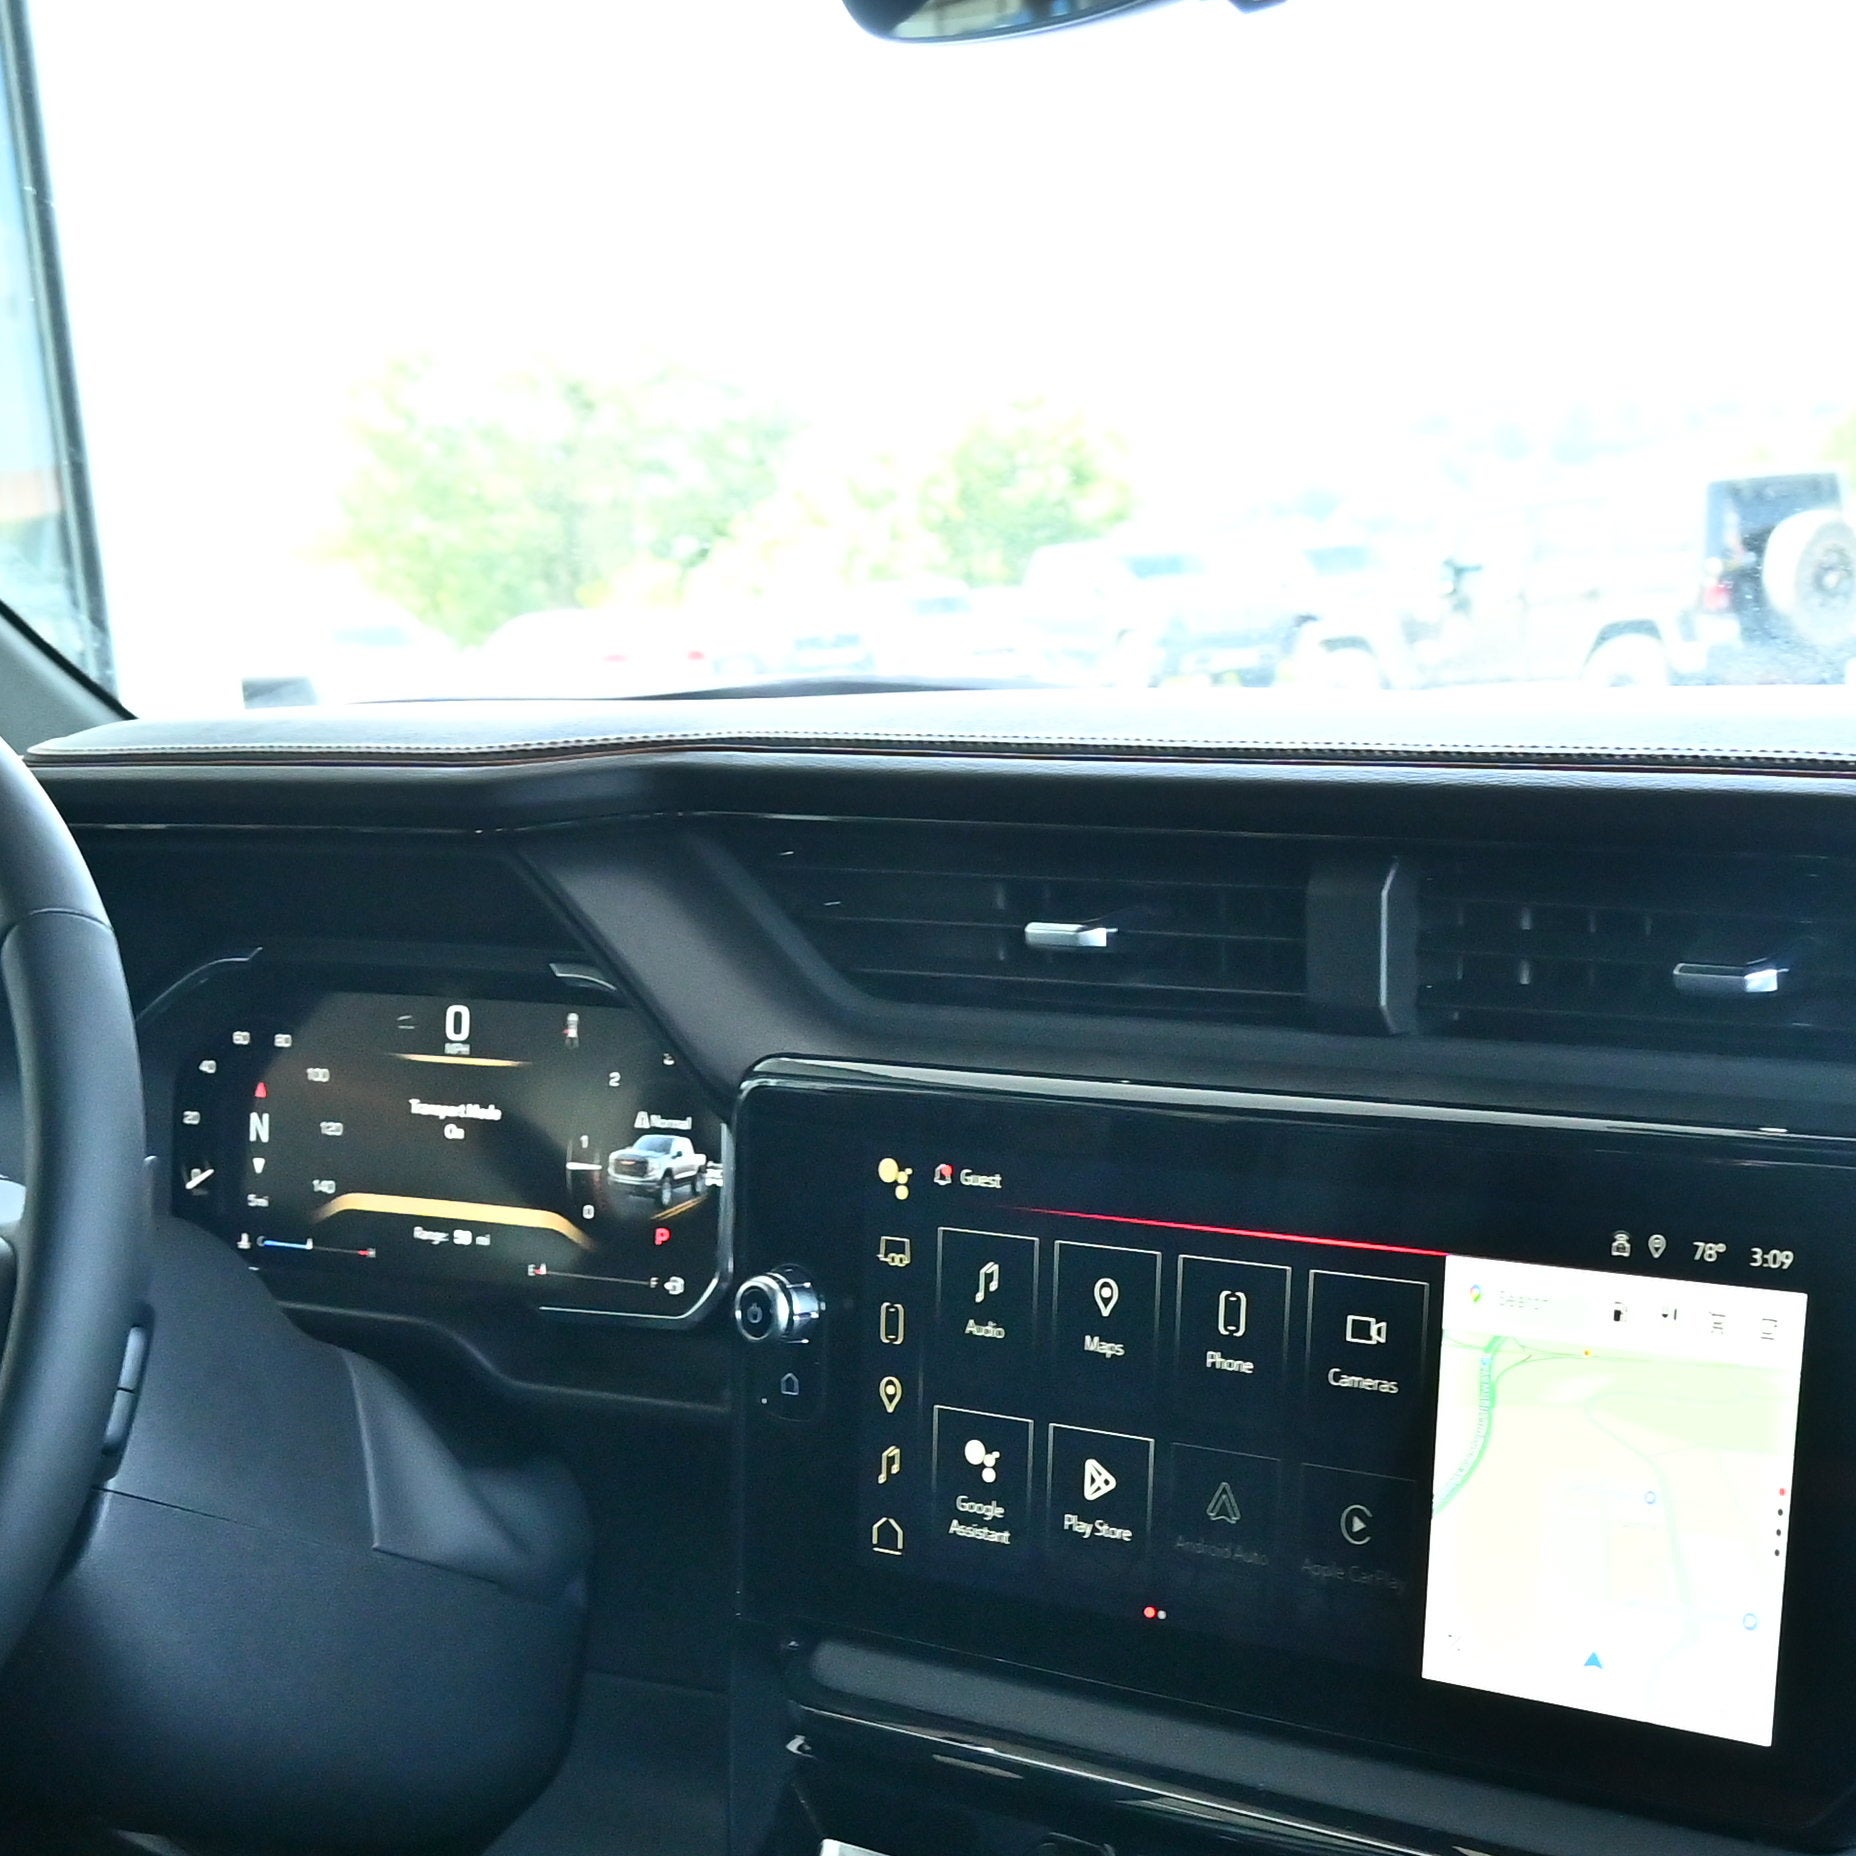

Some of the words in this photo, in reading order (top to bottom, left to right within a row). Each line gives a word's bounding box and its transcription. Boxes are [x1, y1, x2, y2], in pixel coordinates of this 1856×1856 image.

[445, 1004, 471, 1042] 0
[608, 1071, 621, 1088] 2
[248, 1111, 270, 1143] N
[579, 1134, 589, 1149] 1
[959, 1168, 1003, 1189] Guest
[654, 1226, 672, 1246] P
[1749, 1247, 1794, 1270] 3:09
[964, 1319, 1006, 1339] Audio
[1083, 1334, 1126, 1359] Maps
[1205, 1350, 1255, 1374] Phone
[1327, 1367, 1400, 1394] Cameras
[955, 1495, 1006, 1521] Google
[948, 1519, 1012, 1545] Assistant
[1063, 1513, 1094, 1539] Play
[1093, 1519, 1134, 1542] Store
